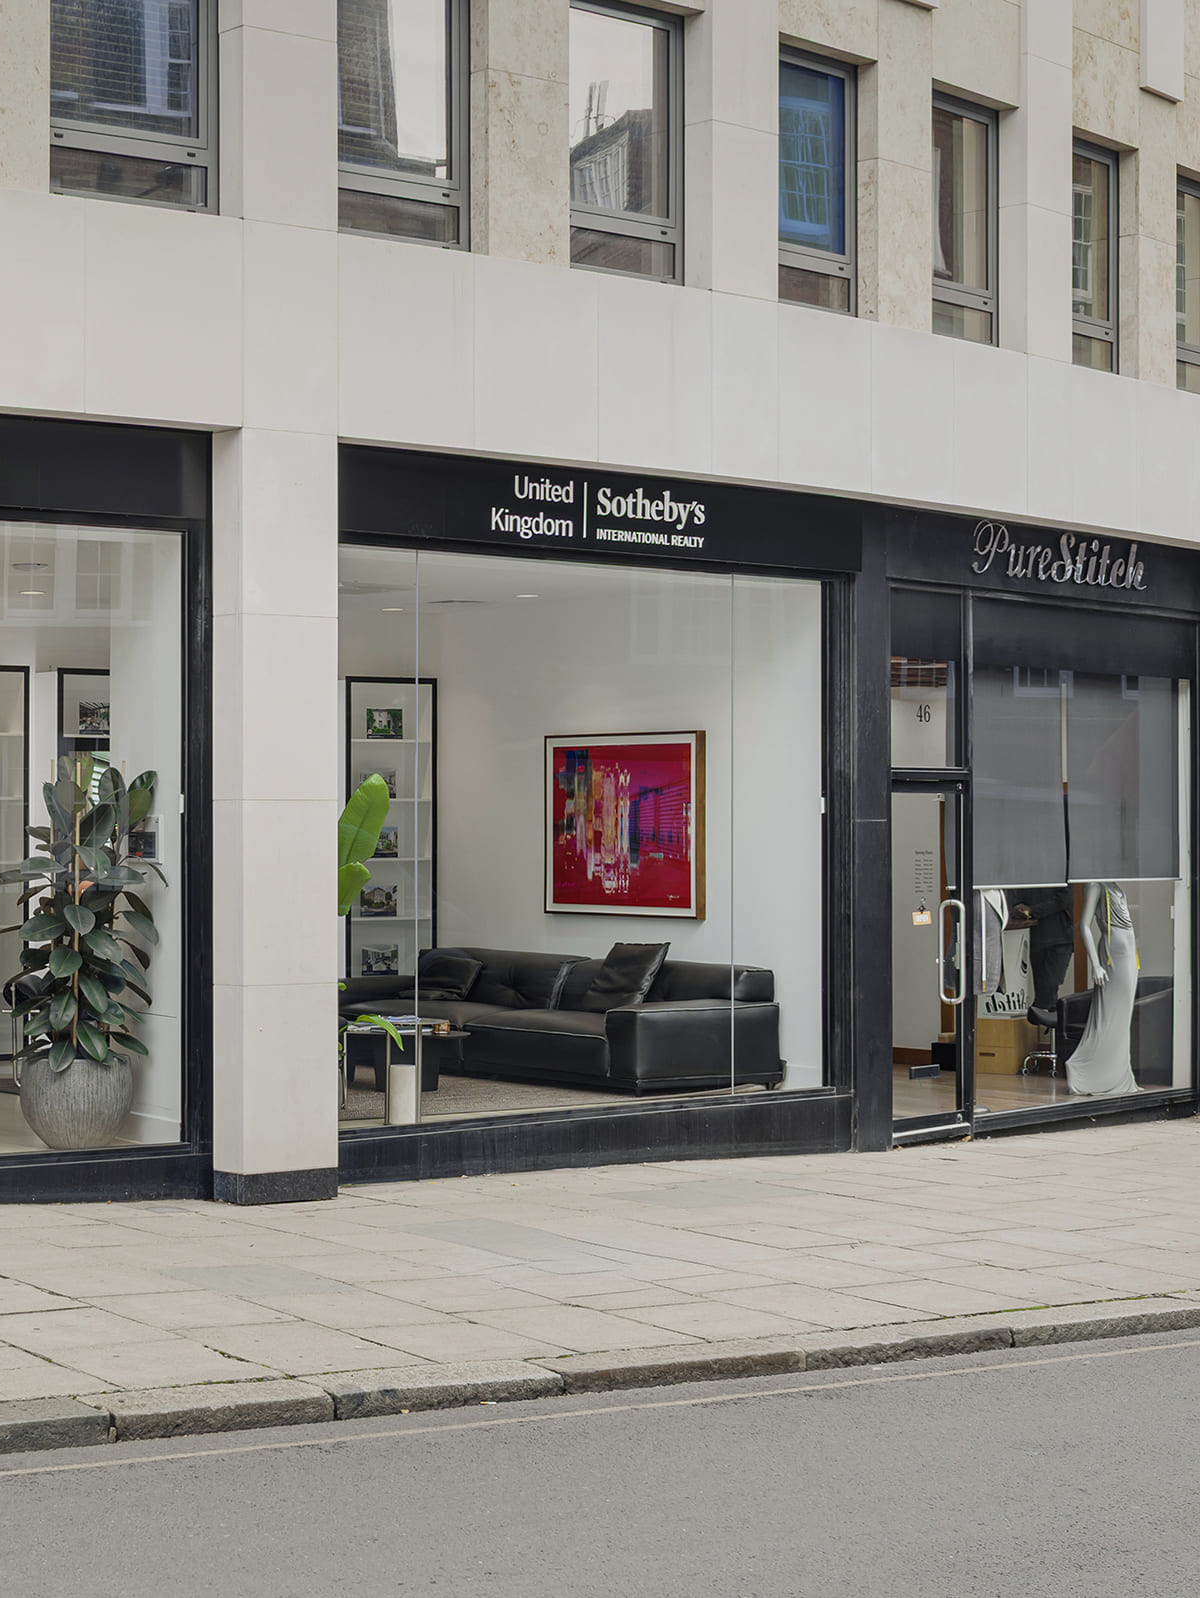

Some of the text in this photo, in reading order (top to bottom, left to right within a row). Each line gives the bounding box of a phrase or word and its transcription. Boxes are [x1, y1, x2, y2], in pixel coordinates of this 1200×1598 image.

[514, 475, 574, 504] United
[491, 507, 574, 540] Kingdom
[596, 487, 706, 531] Sotheby's
[596, 528, 705, 549] INTERNATIONAL REALTY
[972, 519, 1147, 590] PureStitch
[916, 704, 931, 723] 46
